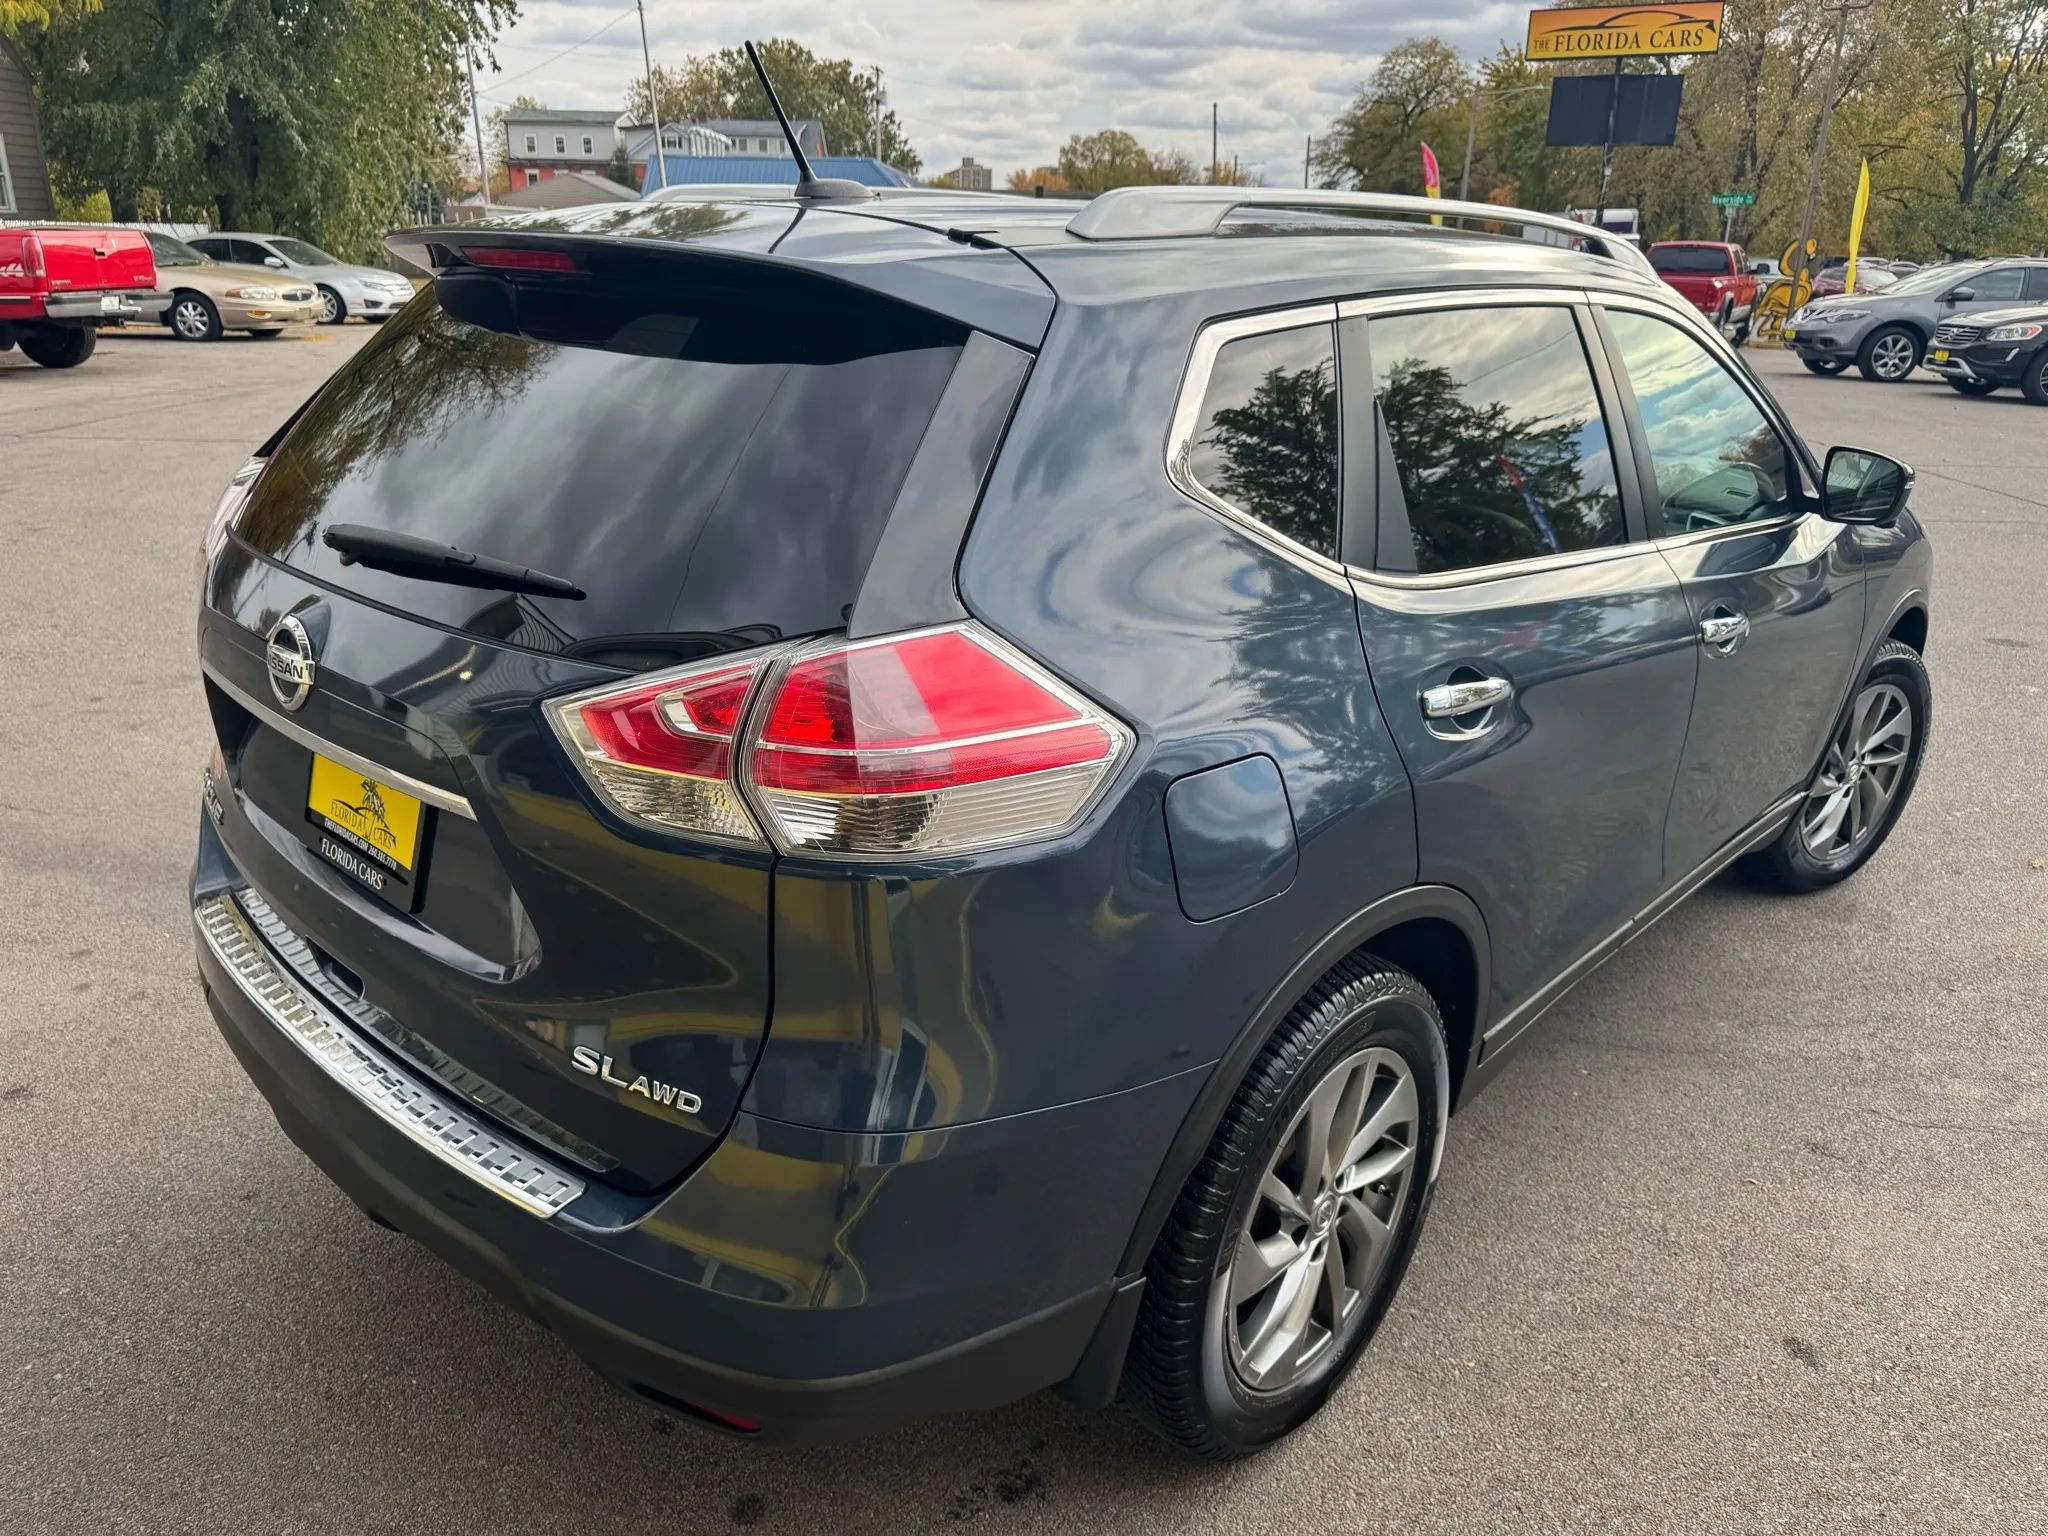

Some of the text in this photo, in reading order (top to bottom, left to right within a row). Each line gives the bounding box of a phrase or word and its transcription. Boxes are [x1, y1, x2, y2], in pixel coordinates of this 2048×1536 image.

[1534, 28, 1704, 52] THE FLORIDA CARS
[1712, 194, 1744, 205] Riverside
[330, 801, 393, 850] FLORIDA CARS
[321, 838, 383, 891] FLORIDA CARS
[571, 1046, 702, 1114] SL AWD
